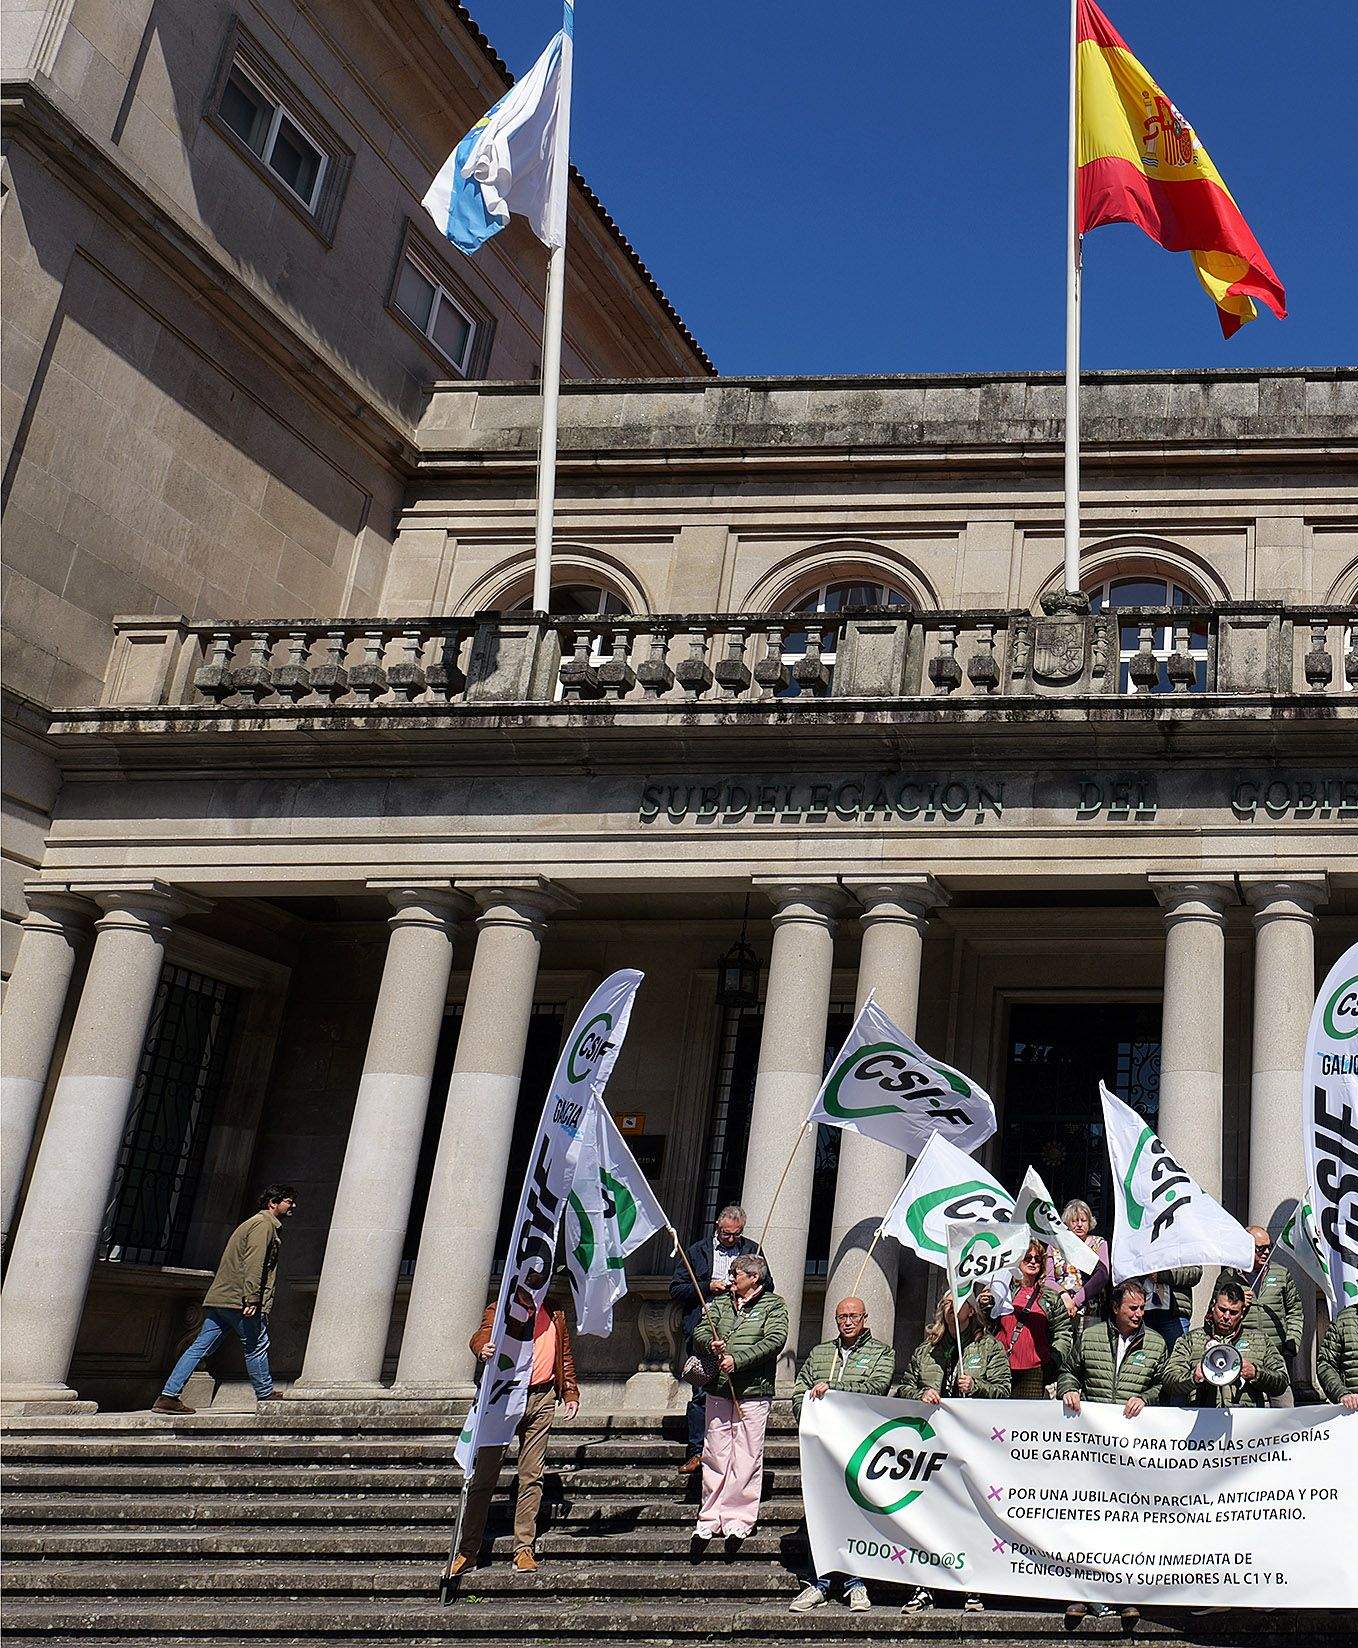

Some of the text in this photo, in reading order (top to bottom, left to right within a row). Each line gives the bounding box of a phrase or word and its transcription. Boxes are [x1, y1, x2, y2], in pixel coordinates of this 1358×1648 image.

[639, 782, 1004, 816] SUBDELEGACION
[1075, 779, 1159, 812] DEL
[959, 1250, 1012, 1277] CSIF
[1011, 1427, 1331, 1451] POR UN ESTATUTO PARA TODAS LAS CATEGORÍAS
[864, 1446, 949, 1482] CSIF
[1010, 1448, 1292, 1469] QUE GARANTICE LA CALIDAD ASISTENCIAL.
[1008, 1488, 1338, 1507] POR UNA JUBILACIÓN PARCIAL, ANTICIPADA Y POR
[1007, 1506, 1306, 1524] COEFICIENTES PARA PERSONAL ESTATUTARIO.
[1011, 1542, 1038, 1556] POR
[1066, 1551, 1155, 1566] ADECUACIÓN
[1158, 1553, 1230, 1566] INMEDIATA
[1234, 1552, 1252, 1565] DE
[1010, 1559, 1288, 1586] TÉCNICOS MEDIOS Y SUPERIORES AL C1 Y B.
